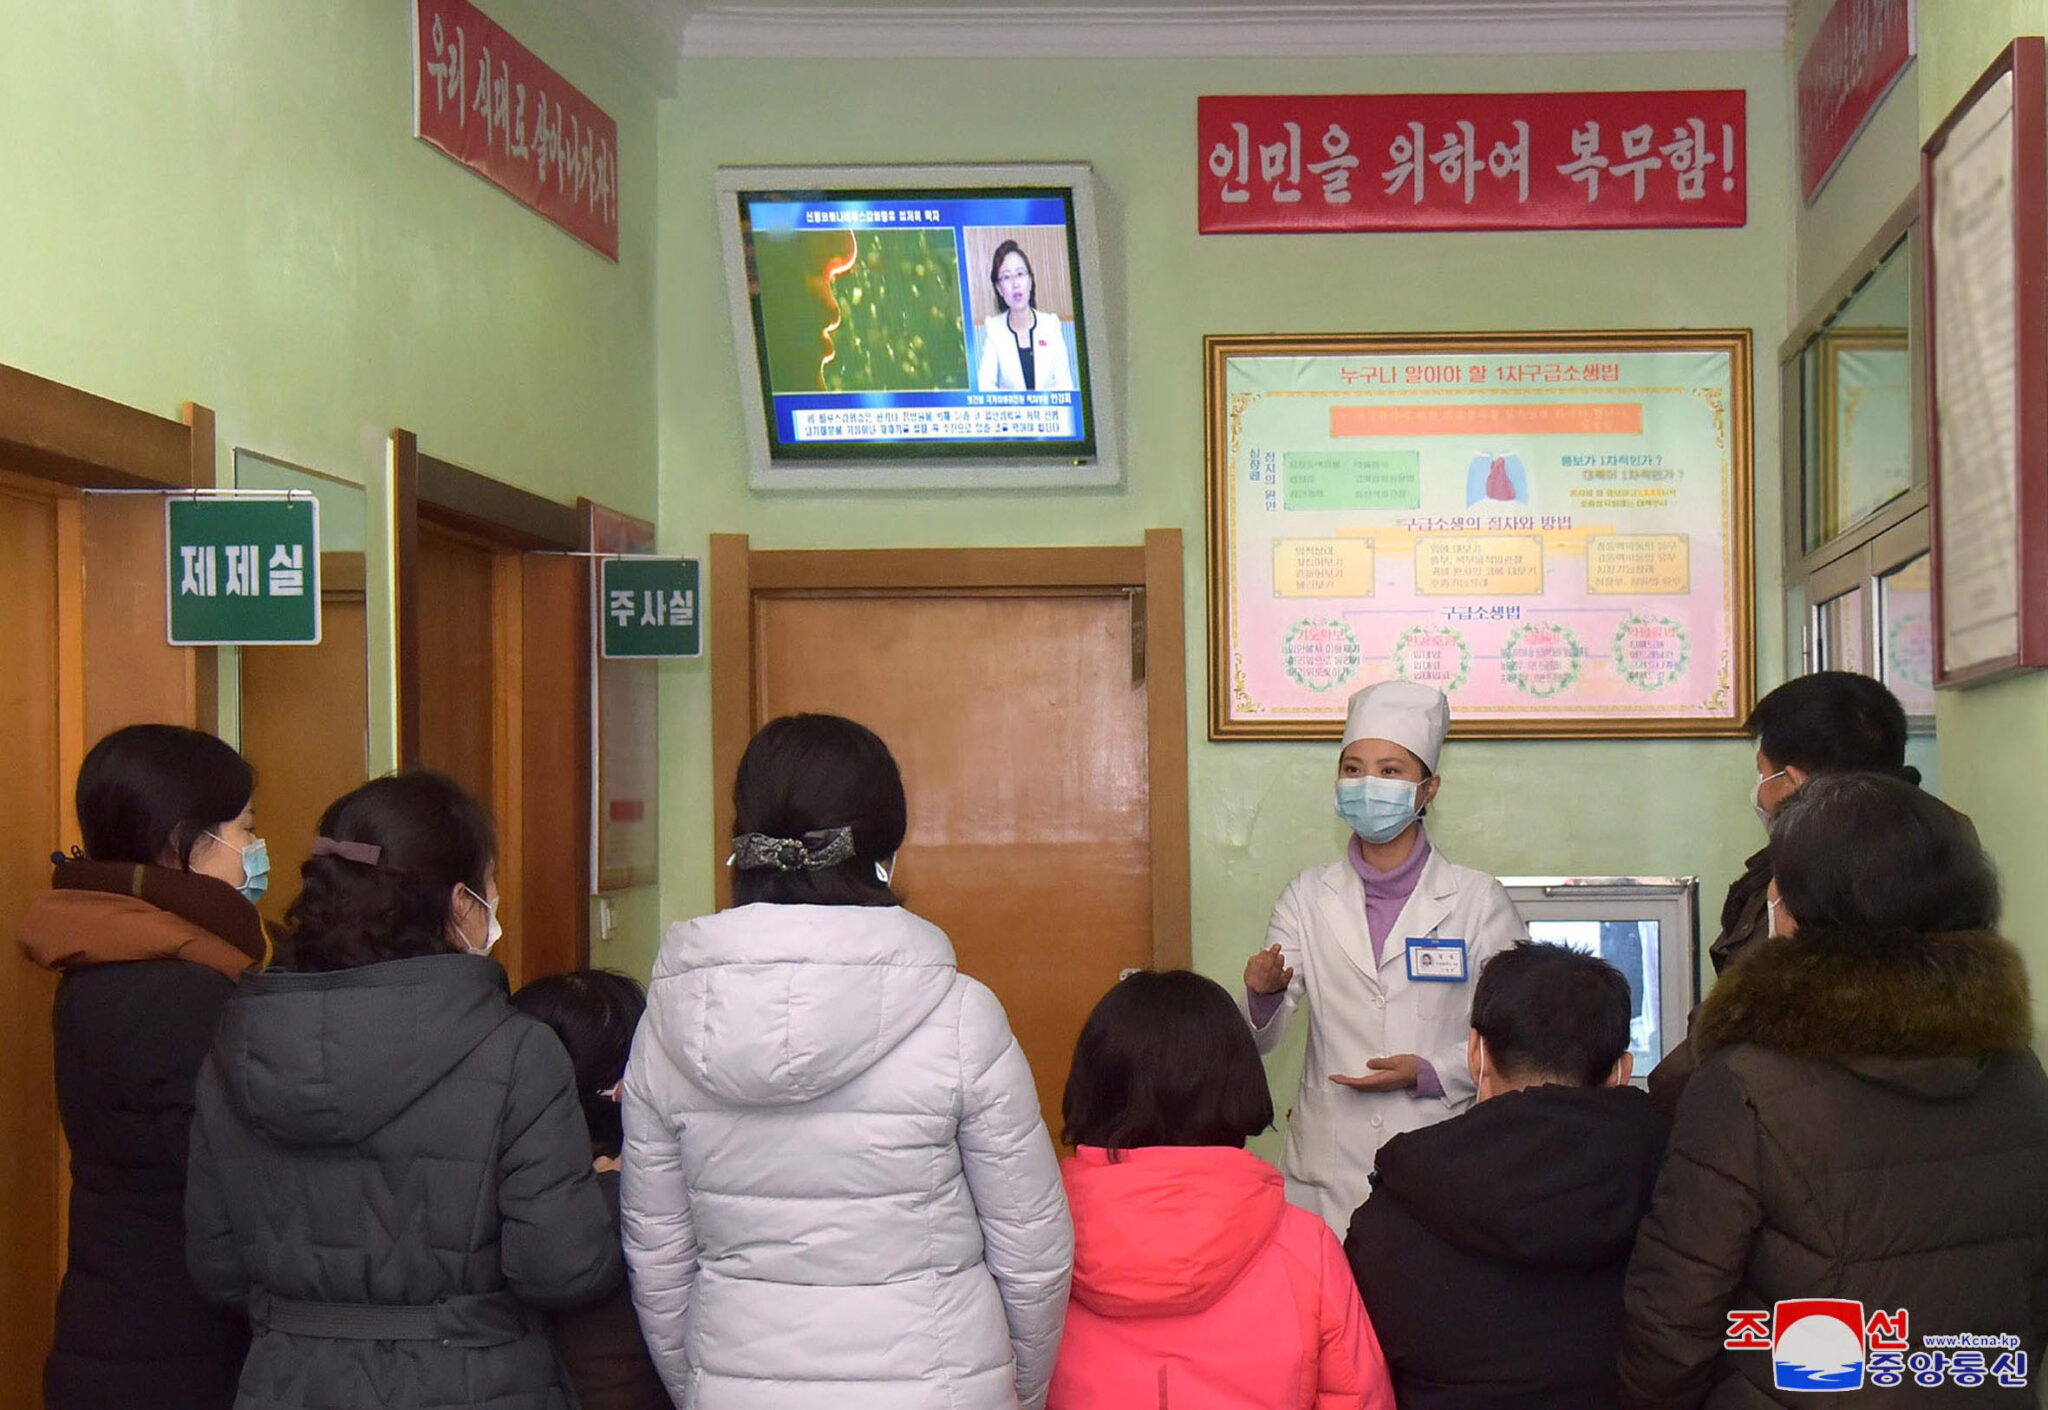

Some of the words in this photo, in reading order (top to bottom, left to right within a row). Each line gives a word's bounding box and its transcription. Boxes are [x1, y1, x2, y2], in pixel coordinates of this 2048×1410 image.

[427, 13, 465, 128] 우리
[472, 46, 529, 162] 식대로
[1209, 121, 1359, 204] 인민을
[1380, 120, 1529, 204] 위하여
[1557, 117, 1735, 201] 복무함!
[1341, 366, 1397, 384] 누구나
[1405, 365, 1461, 384] 알아야
[1469, 365, 1487, 384] 할
[1496, 364, 1620, 384] 1차구급소생법
[1397, 516, 1481, 531] 구급소생의
[1540, 516, 1572, 531] 방법
[180, 544, 304, 597] 제제실
[610, 589, 693, 627] 주사실
[1441, 605, 1521, 620] 구급소생법
